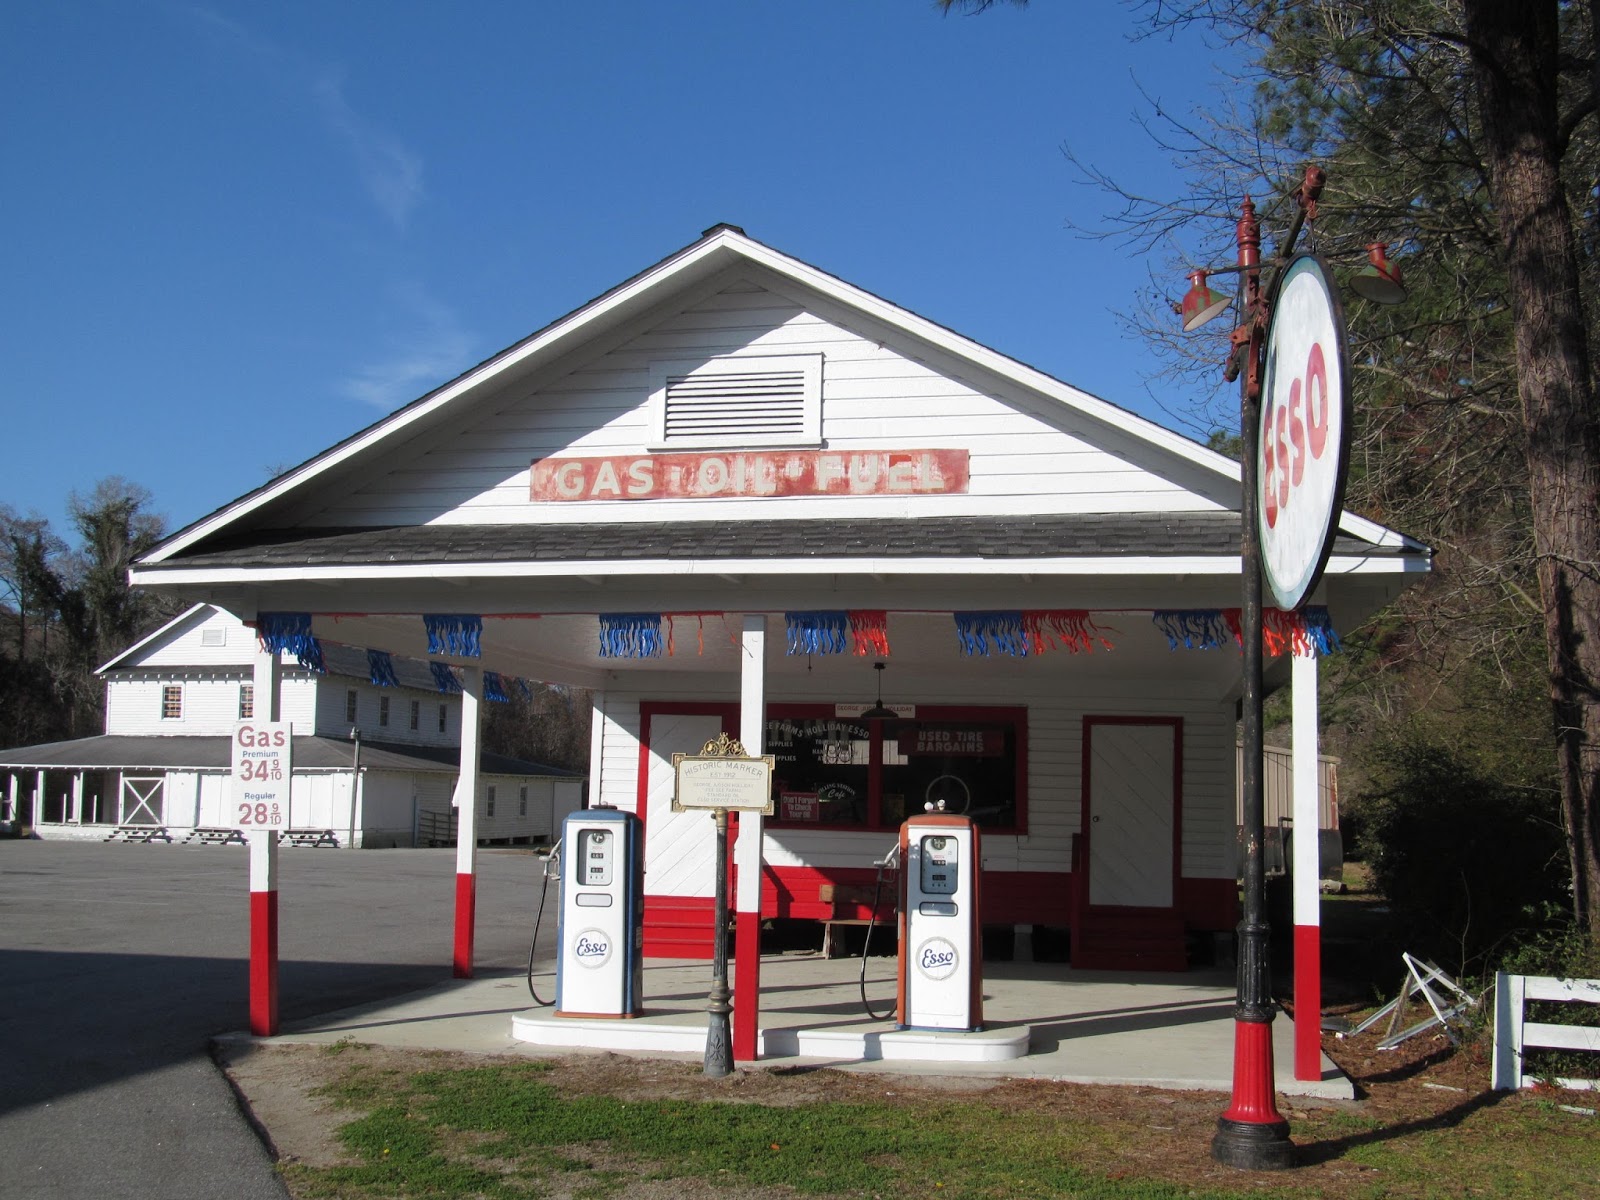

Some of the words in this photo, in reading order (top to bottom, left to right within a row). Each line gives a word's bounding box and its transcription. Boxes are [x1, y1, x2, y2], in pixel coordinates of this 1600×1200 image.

[1263, 342, 1328, 530] ESSO
[556, 460, 655, 497] GAS
[699, 457, 777, 493] OIL
[818, 453, 945, 491] FUEL
[238, 726, 285, 747] Gas
[775, 723, 804, 738] FARMS
[806, 722, 847, 736] HOLLIDAY
[848, 725, 870, 739] ESSO
[918, 731, 950, 742] USED
[956, 731, 984, 742] TIRE
[242, 750, 279, 758] Premium
[917, 741, 985, 753] BARGAINS
[240, 759, 269, 781] 34
[684, 761, 722, 777] HISTORIC
[725, 761, 763, 778] MARKER
[244, 792, 276, 801] Regular
[239, 803, 268, 825] 28
[576, 937, 607, 957] Esso
[921, 948, 954, 969] Esso
